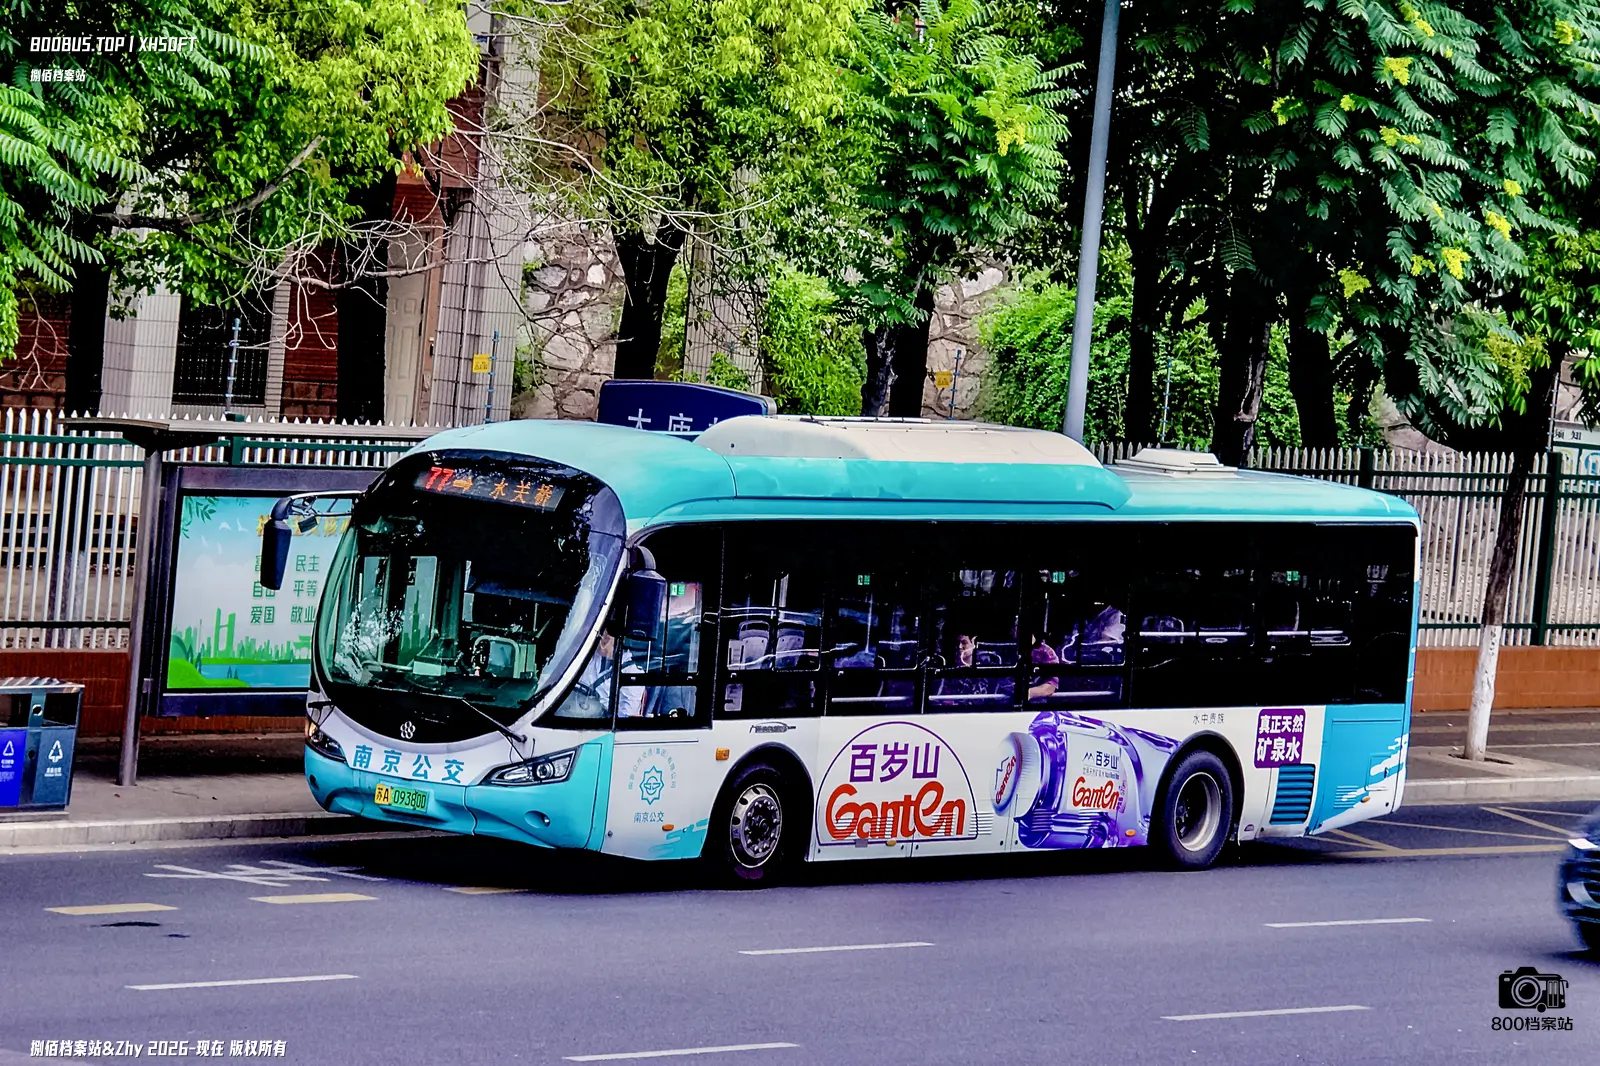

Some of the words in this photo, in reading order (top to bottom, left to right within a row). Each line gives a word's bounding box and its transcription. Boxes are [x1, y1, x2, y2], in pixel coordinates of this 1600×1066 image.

[628, 408, 719, 432] 大庙
[425, 466, 454, 492] 77
[296, 555, 320, 572] 民主
[293, 580, 318, 597] 平等
[250, 606, 275, 624] 爱国
[290, 606, 316, 623] 敬业
[1193, 713, 1225, 724] 水中贵族
[1259, 715, 1304, 734] 真正天然
[1257, 737, 1301, 762] 矿泉水
[353, 745, 465, 783] 南京公交
[851, 742, 940, 783] 百岁山
[1095, 750, 1118, 770] 百岁山
[1072, 776, 1120, 810] Ganten
[633, 811, 664, 823] 南京公交
[825, 781, 966, 840] Ganten
